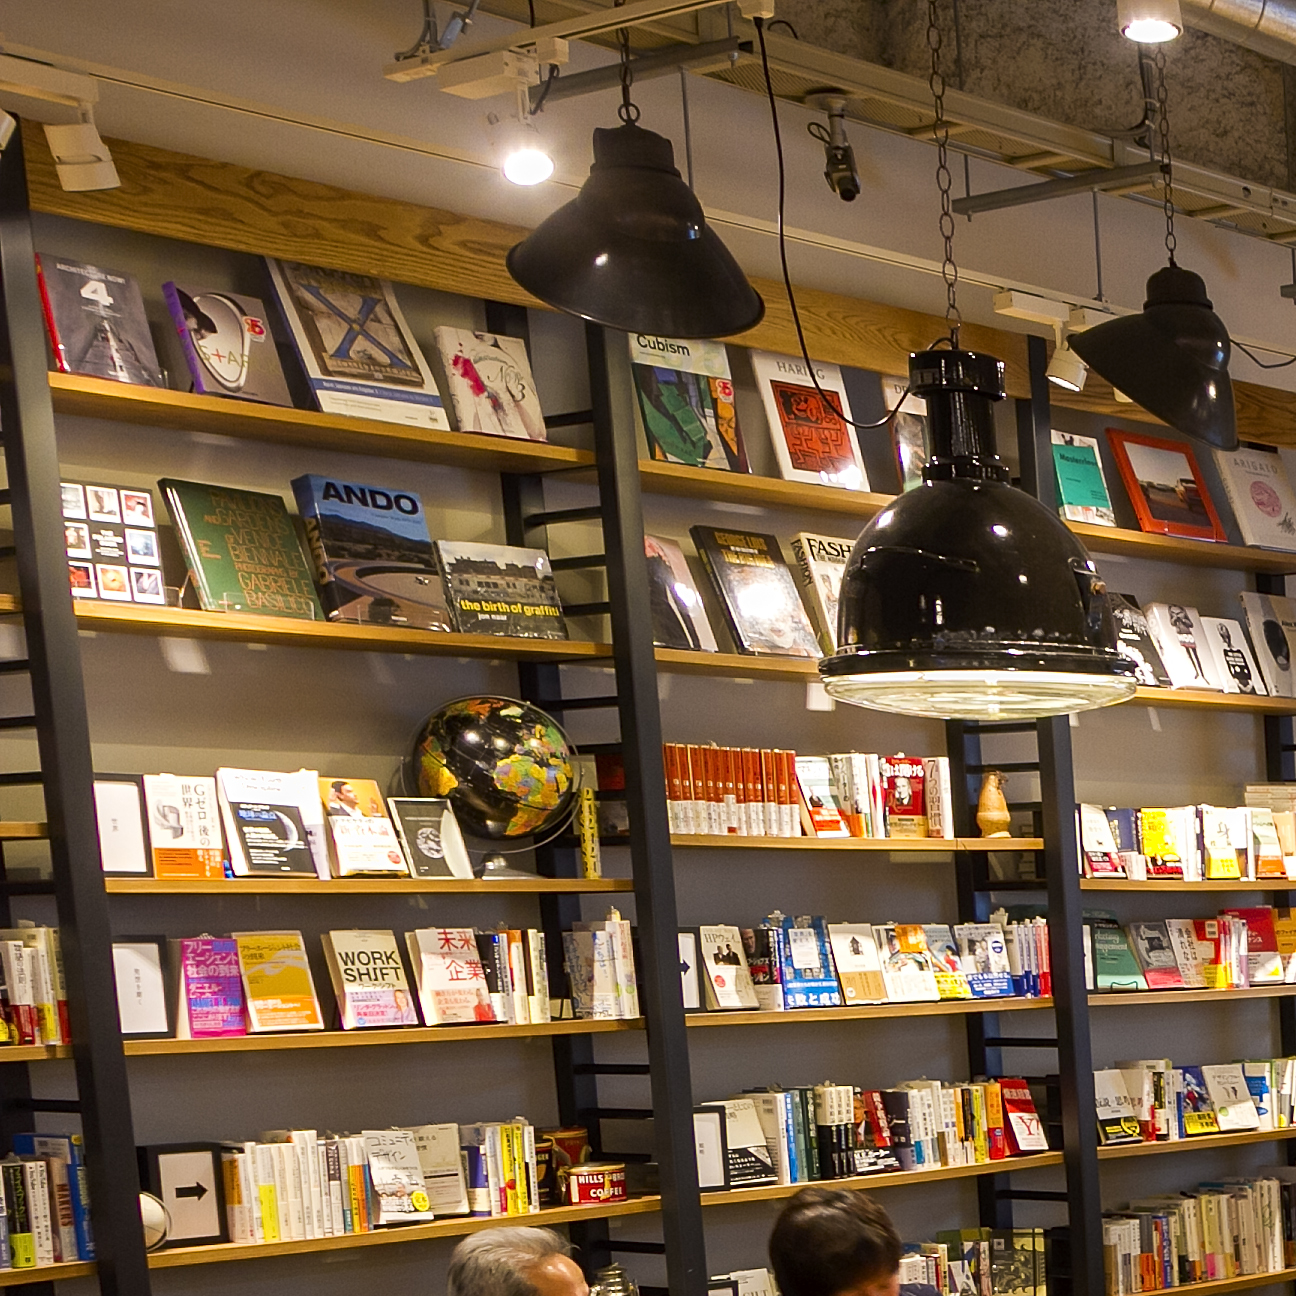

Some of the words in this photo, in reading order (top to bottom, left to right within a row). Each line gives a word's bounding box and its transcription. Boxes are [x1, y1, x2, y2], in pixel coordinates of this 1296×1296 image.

[80, 280, 114, 306] 4
[637, 335, 690, 356] Cubism
[1233, 457, 1278, 475] ARIGATO
[322, 481, 419, 516] ANDO
[216, 508, 288, 535] GARDENS
[230, 528, 282, 550] VENICE
[806, 537, 851, 561] FASH
[238, 572, 313, 597] GABRIELE
[246, 590, 313, 614] BASILICO
[461, 600, 481, 612] the
[482, 600, 510, 614] birth
[511, 603, 522, 614] of
[523, 604, 560, 619] graffiti
[184, 941, 212, 953] フリー
[437, 929, 476, 951] 未来
[185, 952, 238, 965] エージェント
[338, 951, 400, 966] WORK
[187, 965, 240, 978] 社会の到来
[344, 967, 401, 982] SHIFT
[445, 959, 485, 982] 企業
[1017, 1116, 1041, 1136] Y!
[579, 1175, 603, 1183] HILLS
[590, 1187, 622, 1198] COFFEE
[57, 1184, 74, 1226] MAKERS
